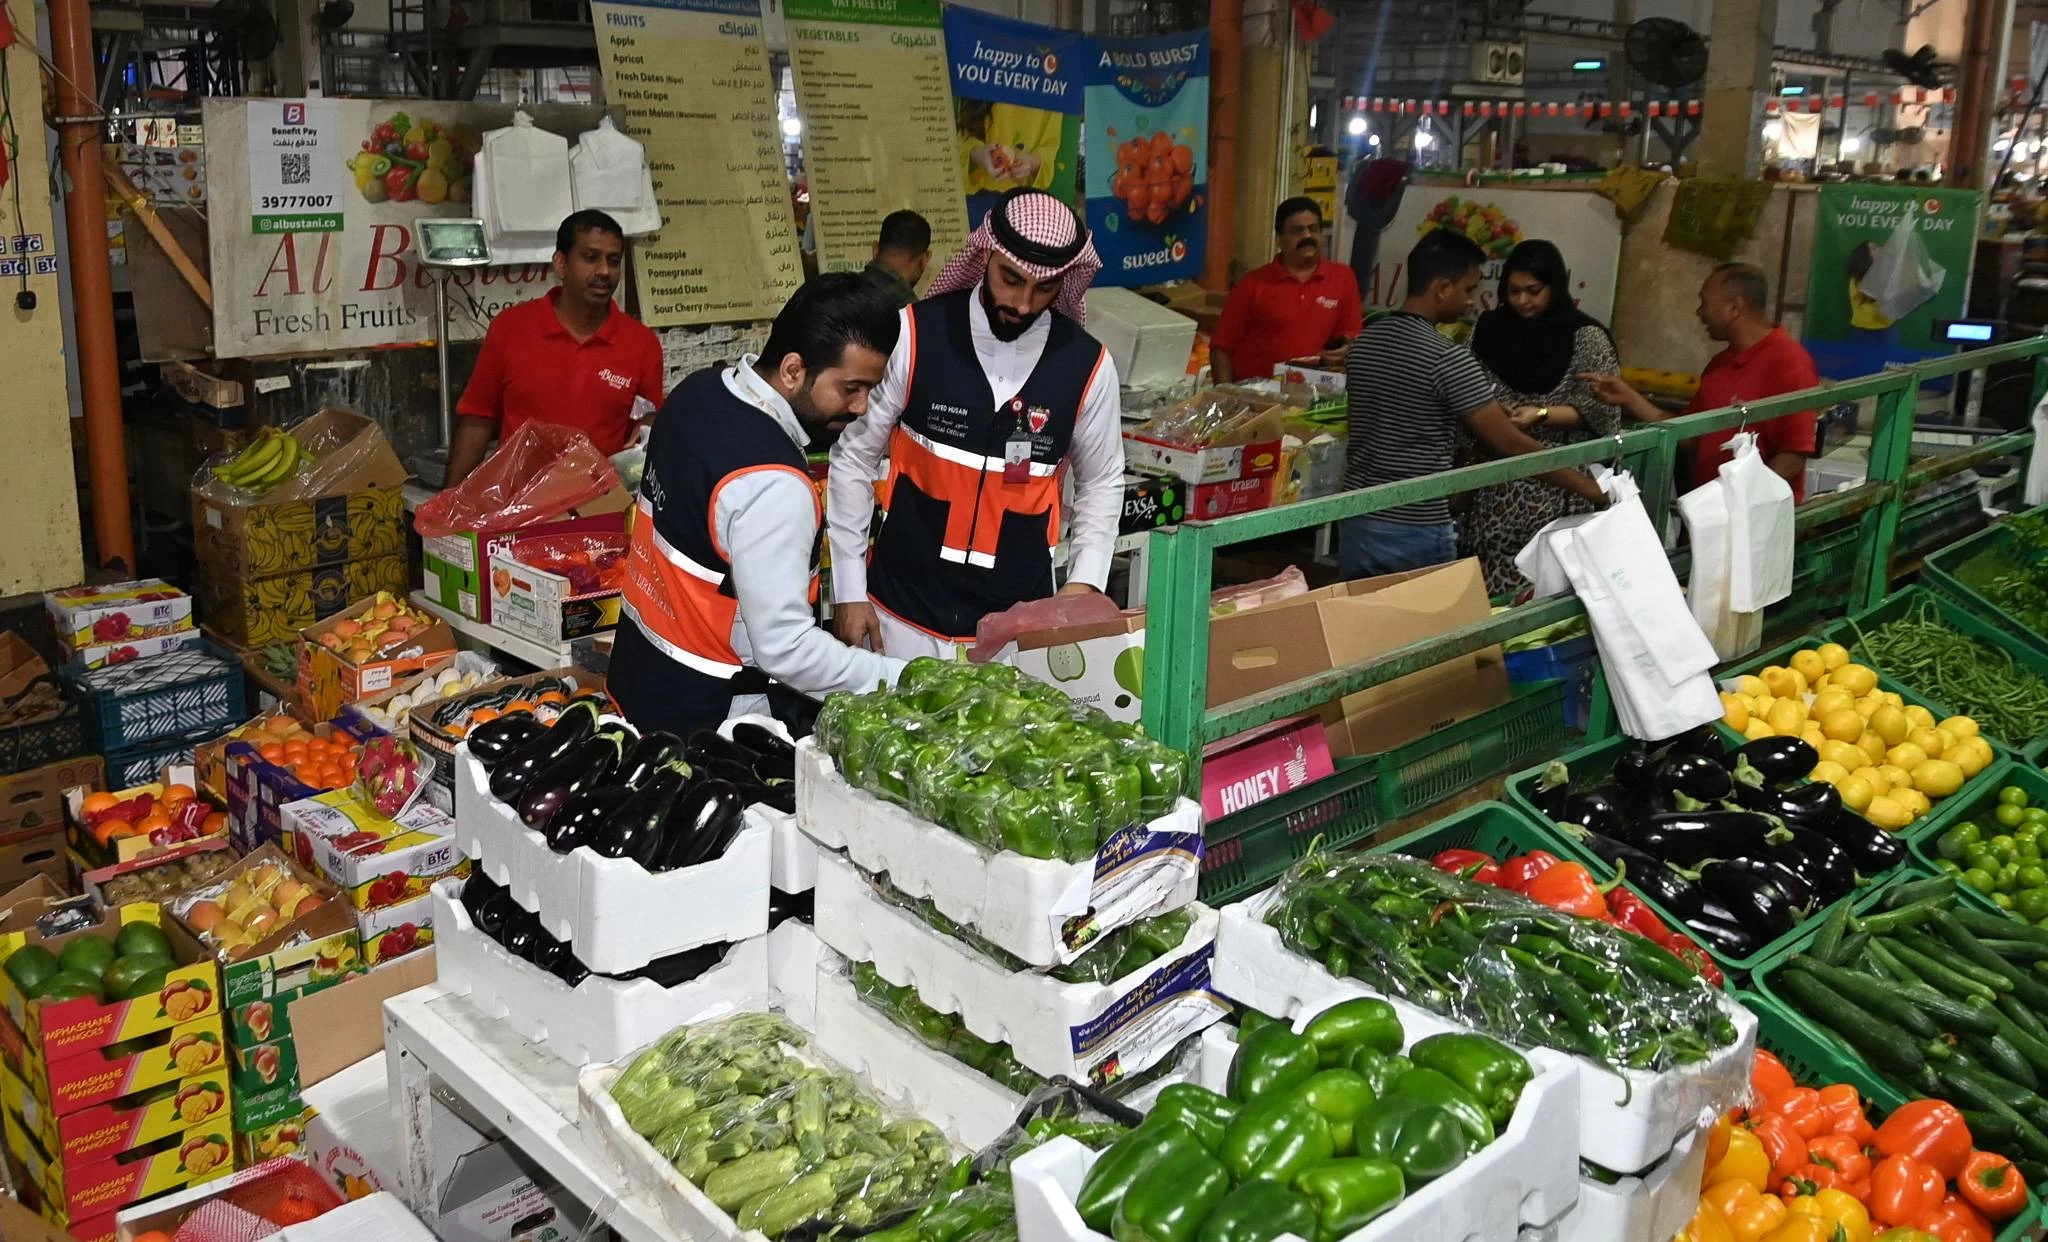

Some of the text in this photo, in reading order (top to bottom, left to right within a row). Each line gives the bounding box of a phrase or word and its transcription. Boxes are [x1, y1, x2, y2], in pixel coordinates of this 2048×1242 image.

[878, 1, 897, 10] LIST
[606, 13, 646, 28] FRUITS
[610, 35, 635, 48] Apple
[796, 28, 860, 42] VEGETABLES
[613, 52, 644, 65] Apricot
[974, 41, 1022, 68] happy
[1026, 55, 1040, 69] to
[1099, 44, 1199, 67] A BOLD BURST
[615, 71, 639, 82] Fresh
[641, 73, 664, 84] Dates
[957, 63, 1067, 97] YOU EVERY DAY
[618, 88, 669, 101] Fresh Grape
[625, 108, 648, 118] reen
[649, 108, 675, 119] Melon
[272, 127, 318, 137] Benefit Pay
[625, 125, 652, 136] Guava
[261, 194, 334, 209] 39777007
[1850, 195, 1900, 214] happy
[273, 218, 337, 230] albustani.co
[1837, 213, 1867, 227] YOU
[1923, 217, 1955, 232] DAY
[644, 248, 687, 262] Pineapple
[252, 230, 334, 298] Al
[648, 266, 703, 279] Pomegranate
[650, 283, 708, 297] Pressed Dates
[653, 303, 674, 315] Sour
[675, 301, 703, 314] Cherry
[253, 307, 332, 336] Fresh
[339, 300, 417, 330] Fruits
[947, 406, 969, 417] HUSAIN
[1231, 478, 1260, 492] Dragon
[1124, 496, 1157, 517] EXSA
[1220, 766, 1280, 816] HONEY
[428, 847, 450, 866] BTC
[46, 1013, 113, 1041] MPHASHANE
[57, 1026, 104, 1047] MANGOES
[57, 1067, 124, 1096] MPHASHANE
[69, 1080, 115, 1102] MANGOES
[65, 1120, 130, 1150] MPHASHANE
[76, 1133, 121, 1156] MANGOES
[71, 1172, 136, 1203] MPHASHANE
[82, 1184, 127, 1209] MANGOES
